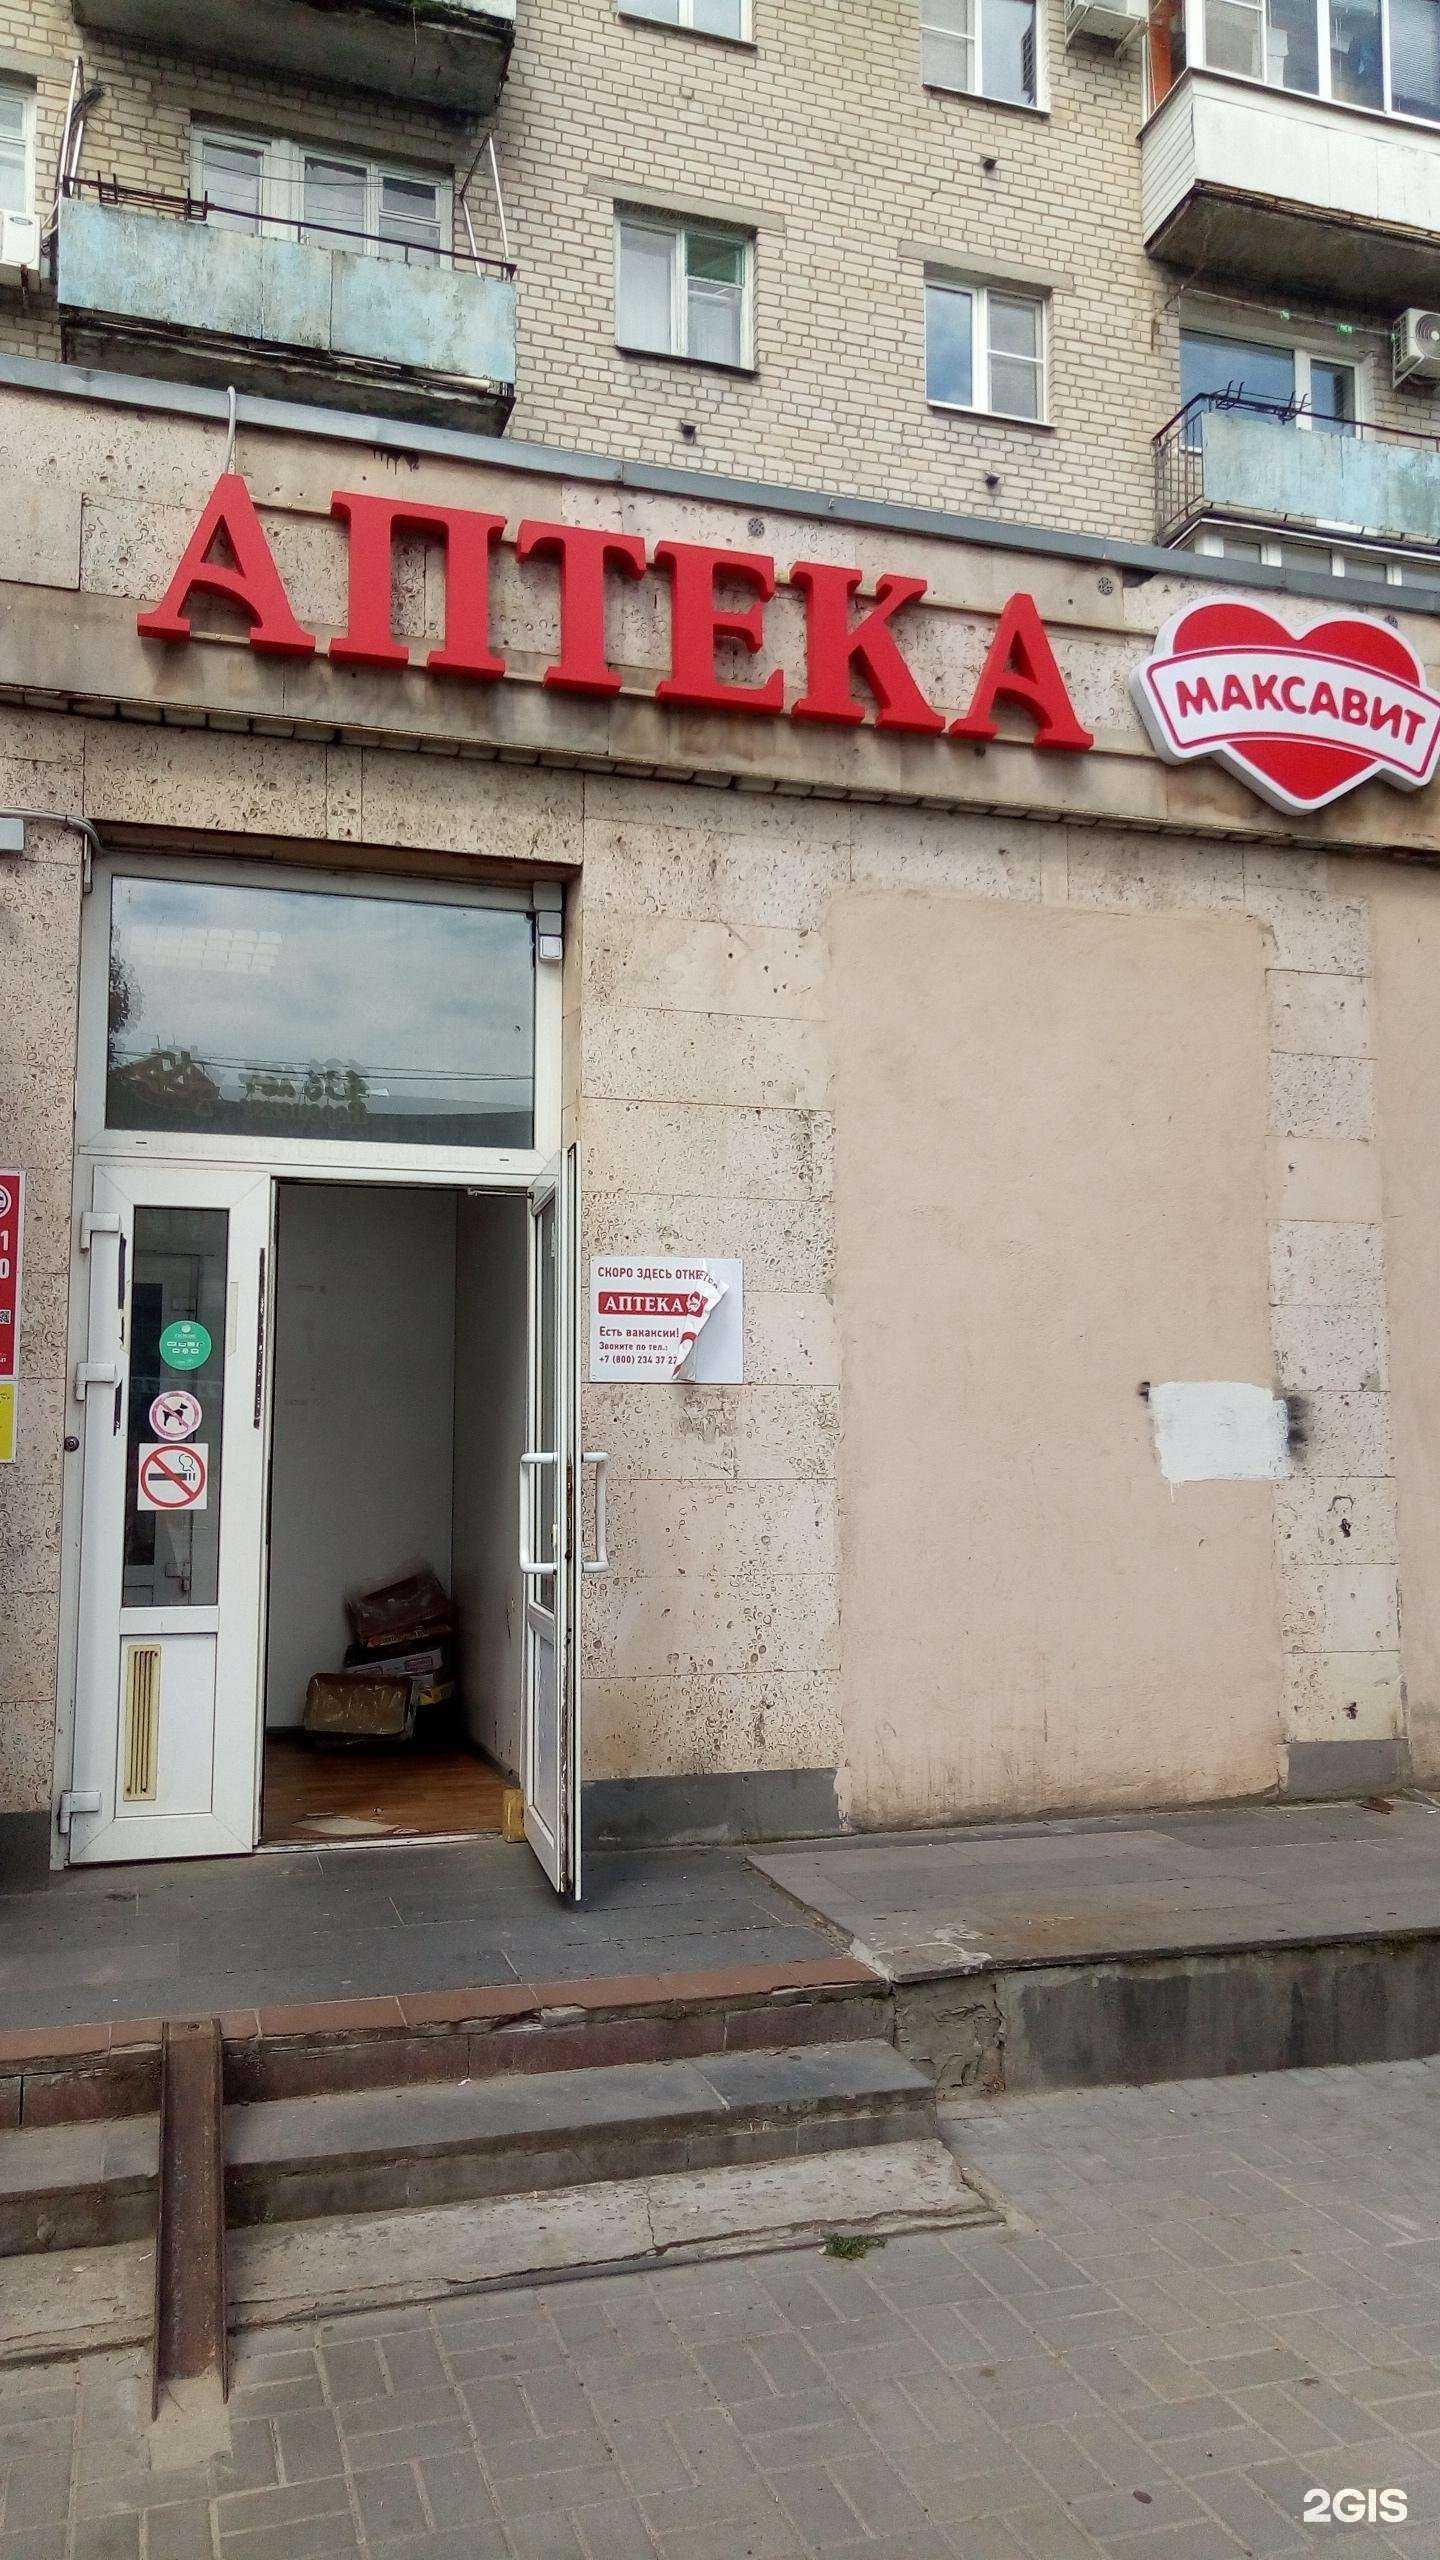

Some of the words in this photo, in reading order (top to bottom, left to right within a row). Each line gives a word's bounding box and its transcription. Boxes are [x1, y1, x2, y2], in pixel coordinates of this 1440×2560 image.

[137, 473, 1095, 750] АПТЕКА
[1174, 673, 1427, 747] МАКСАВИТ
[598, 1266, 633, 1278] СКОРО
[637, 1267, 672, 1280] ЗДЕСЬ
[603, 1295, 685, 1313] АПТЕКА
[599, 1326, 623, 1337] Есть
[626, 1327, 680, 1338] вакансии!
[598, 1341, 634, 1351] Звоните
[598, 1355, 609, 1364] +7
[612, 1355, 635, 1365] (800)
[637, 1356, 653, 1364] 234
[655, 1356, 665, 1364] 37
